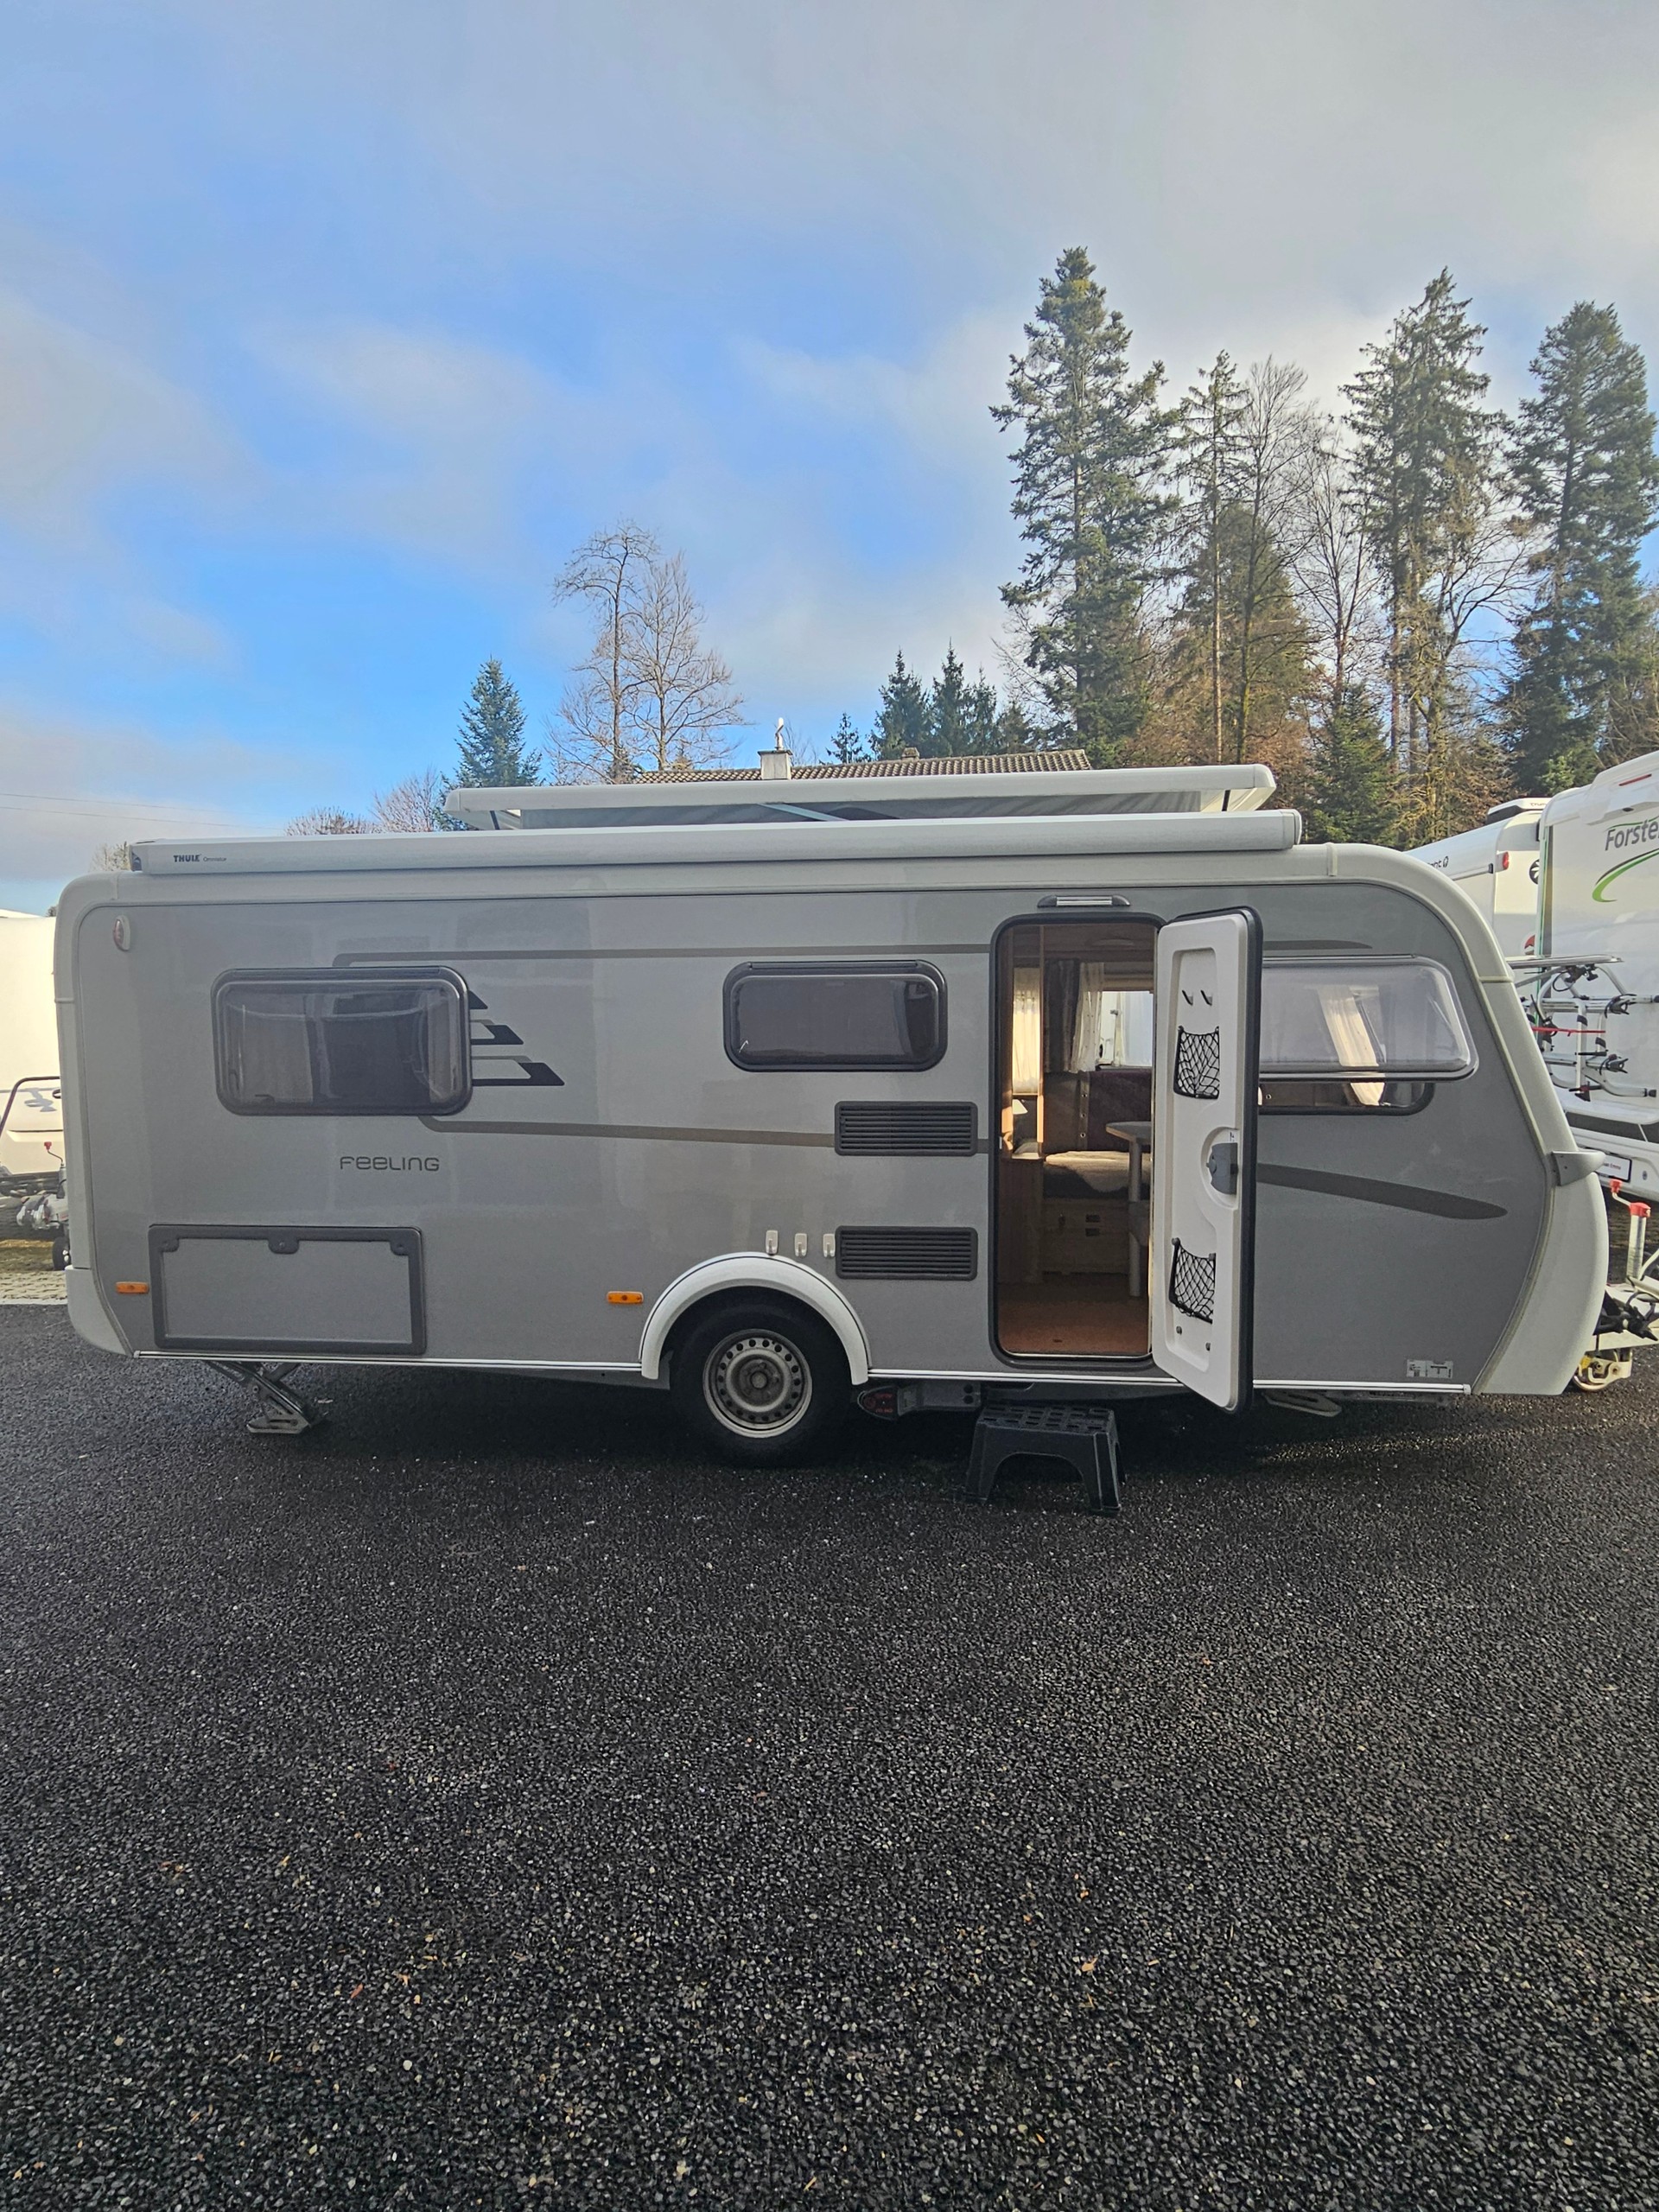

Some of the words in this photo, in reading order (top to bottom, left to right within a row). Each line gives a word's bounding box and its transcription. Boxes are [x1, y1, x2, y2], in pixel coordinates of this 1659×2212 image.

[1605, 819, 1659, 851] Forste
[173, 854, 200, 863] THULE
[340, 1156, 440, 1172] FEELING
